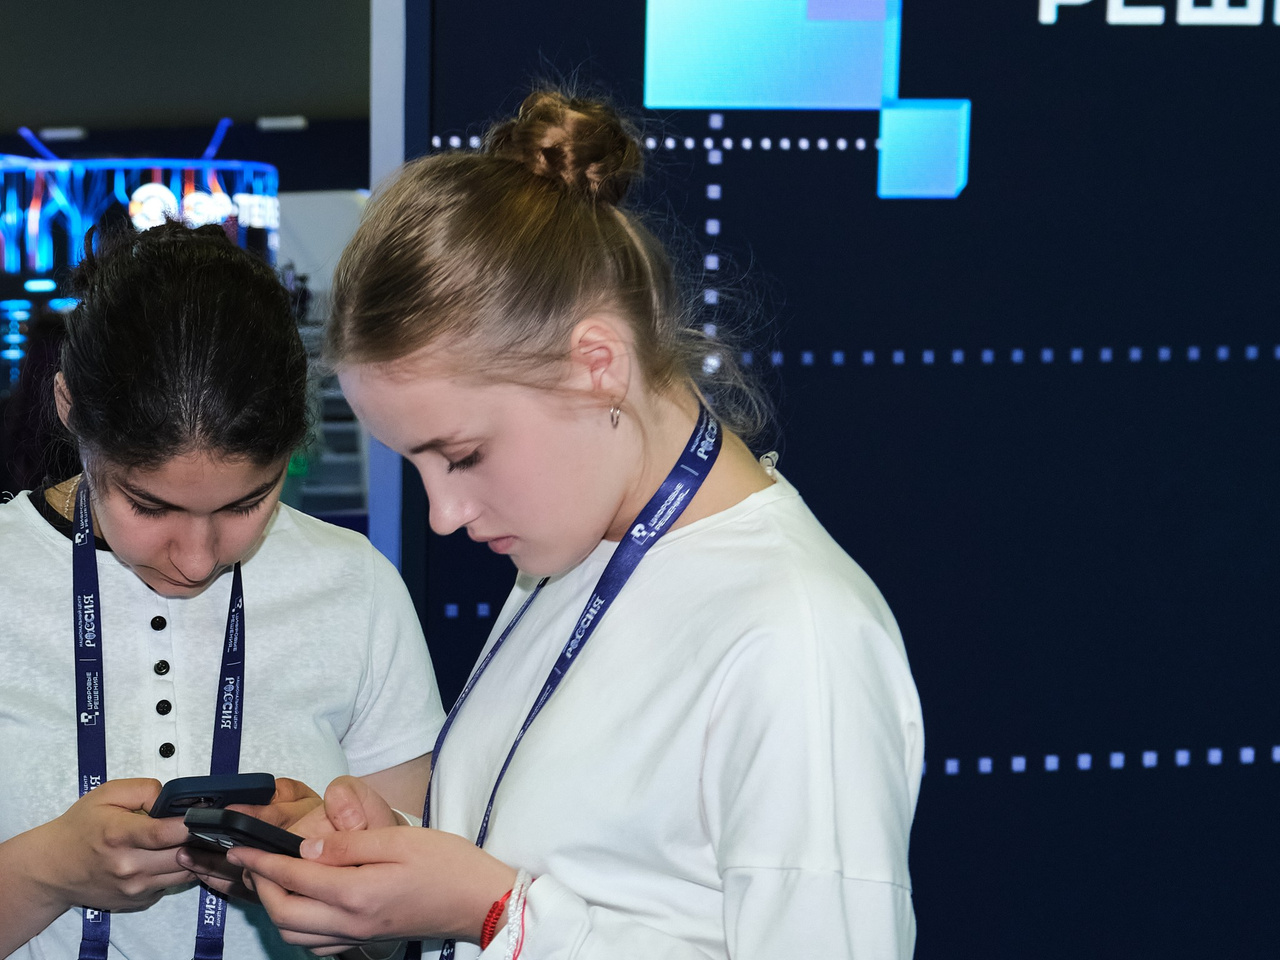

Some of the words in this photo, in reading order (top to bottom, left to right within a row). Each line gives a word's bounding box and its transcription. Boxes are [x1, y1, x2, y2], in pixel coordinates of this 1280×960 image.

[83, 594, 96, 648] РОССИЯ
[565, 596, 606, 659] РОССИЯ
[221, 676, 235, 730] РОССИЯ
